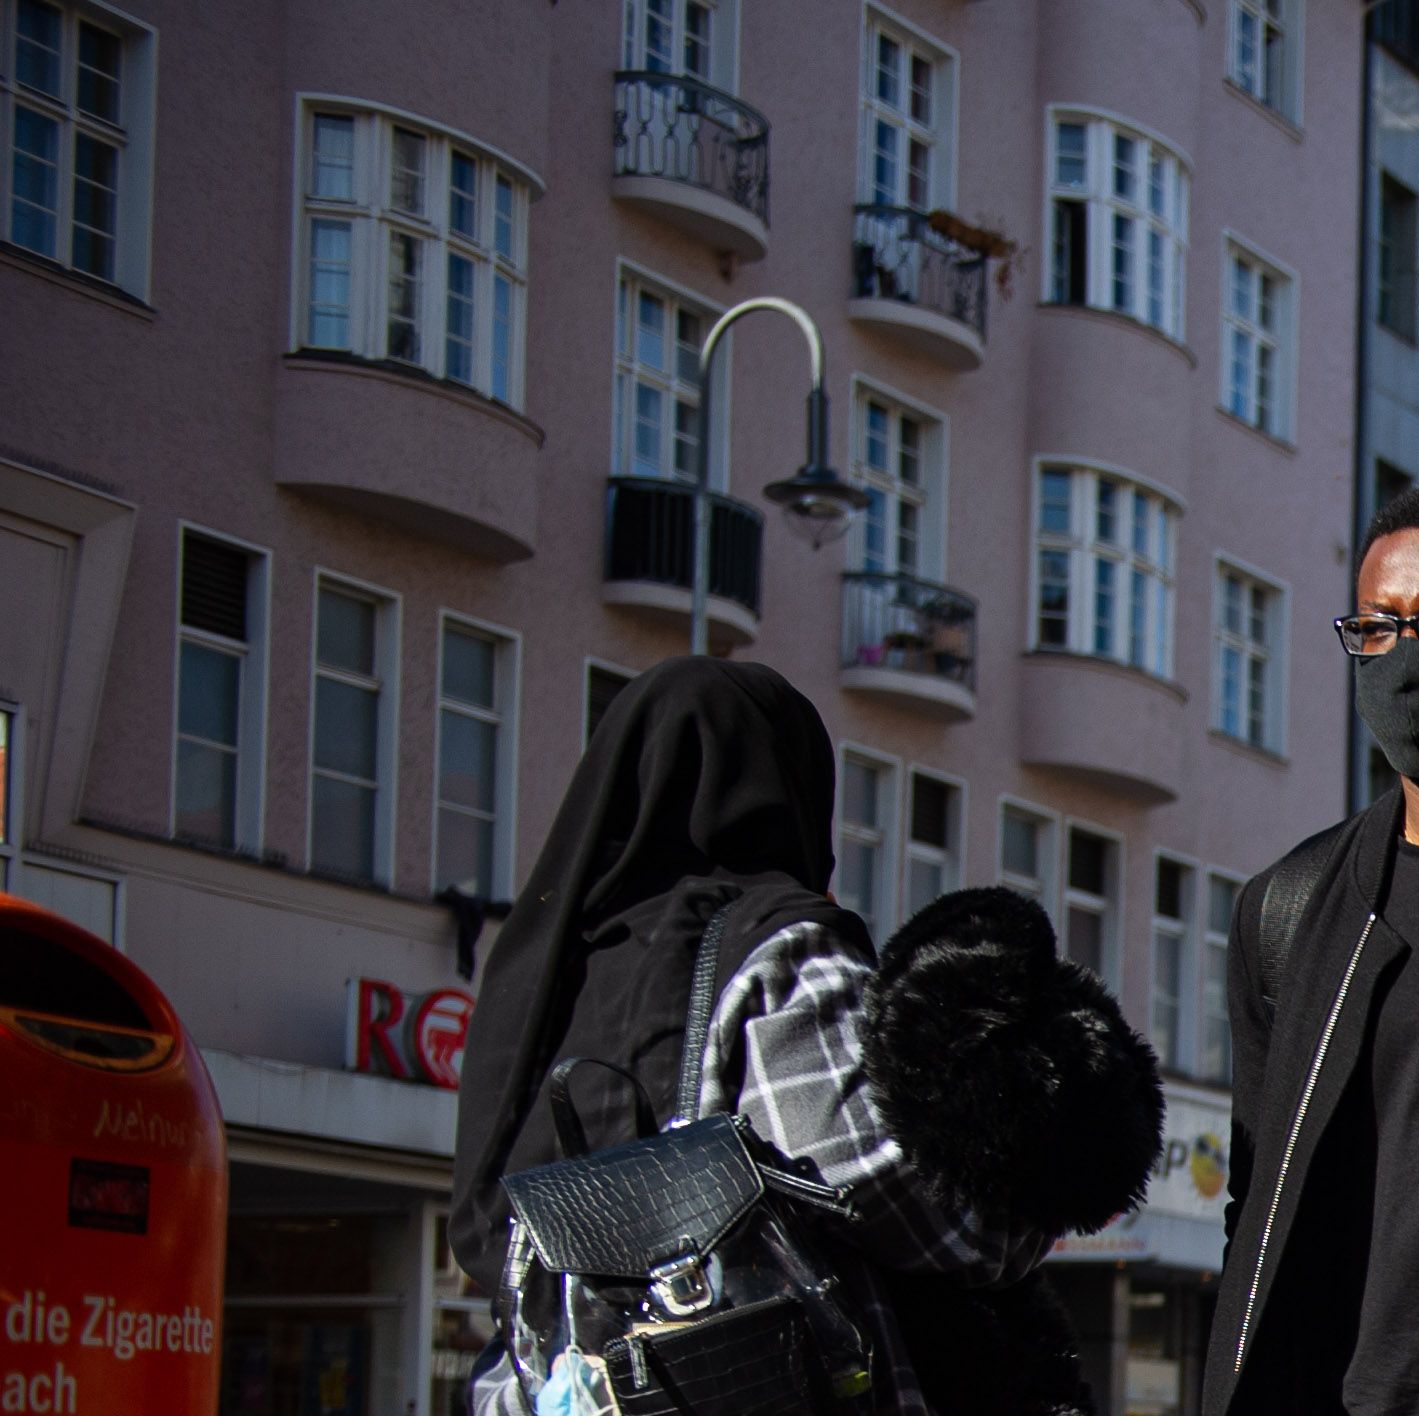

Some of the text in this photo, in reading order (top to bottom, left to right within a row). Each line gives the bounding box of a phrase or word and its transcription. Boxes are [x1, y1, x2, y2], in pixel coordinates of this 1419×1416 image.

[6, 1291, 215, 1360] die Zigarette
[2, 1361, 78, 1415] ach
